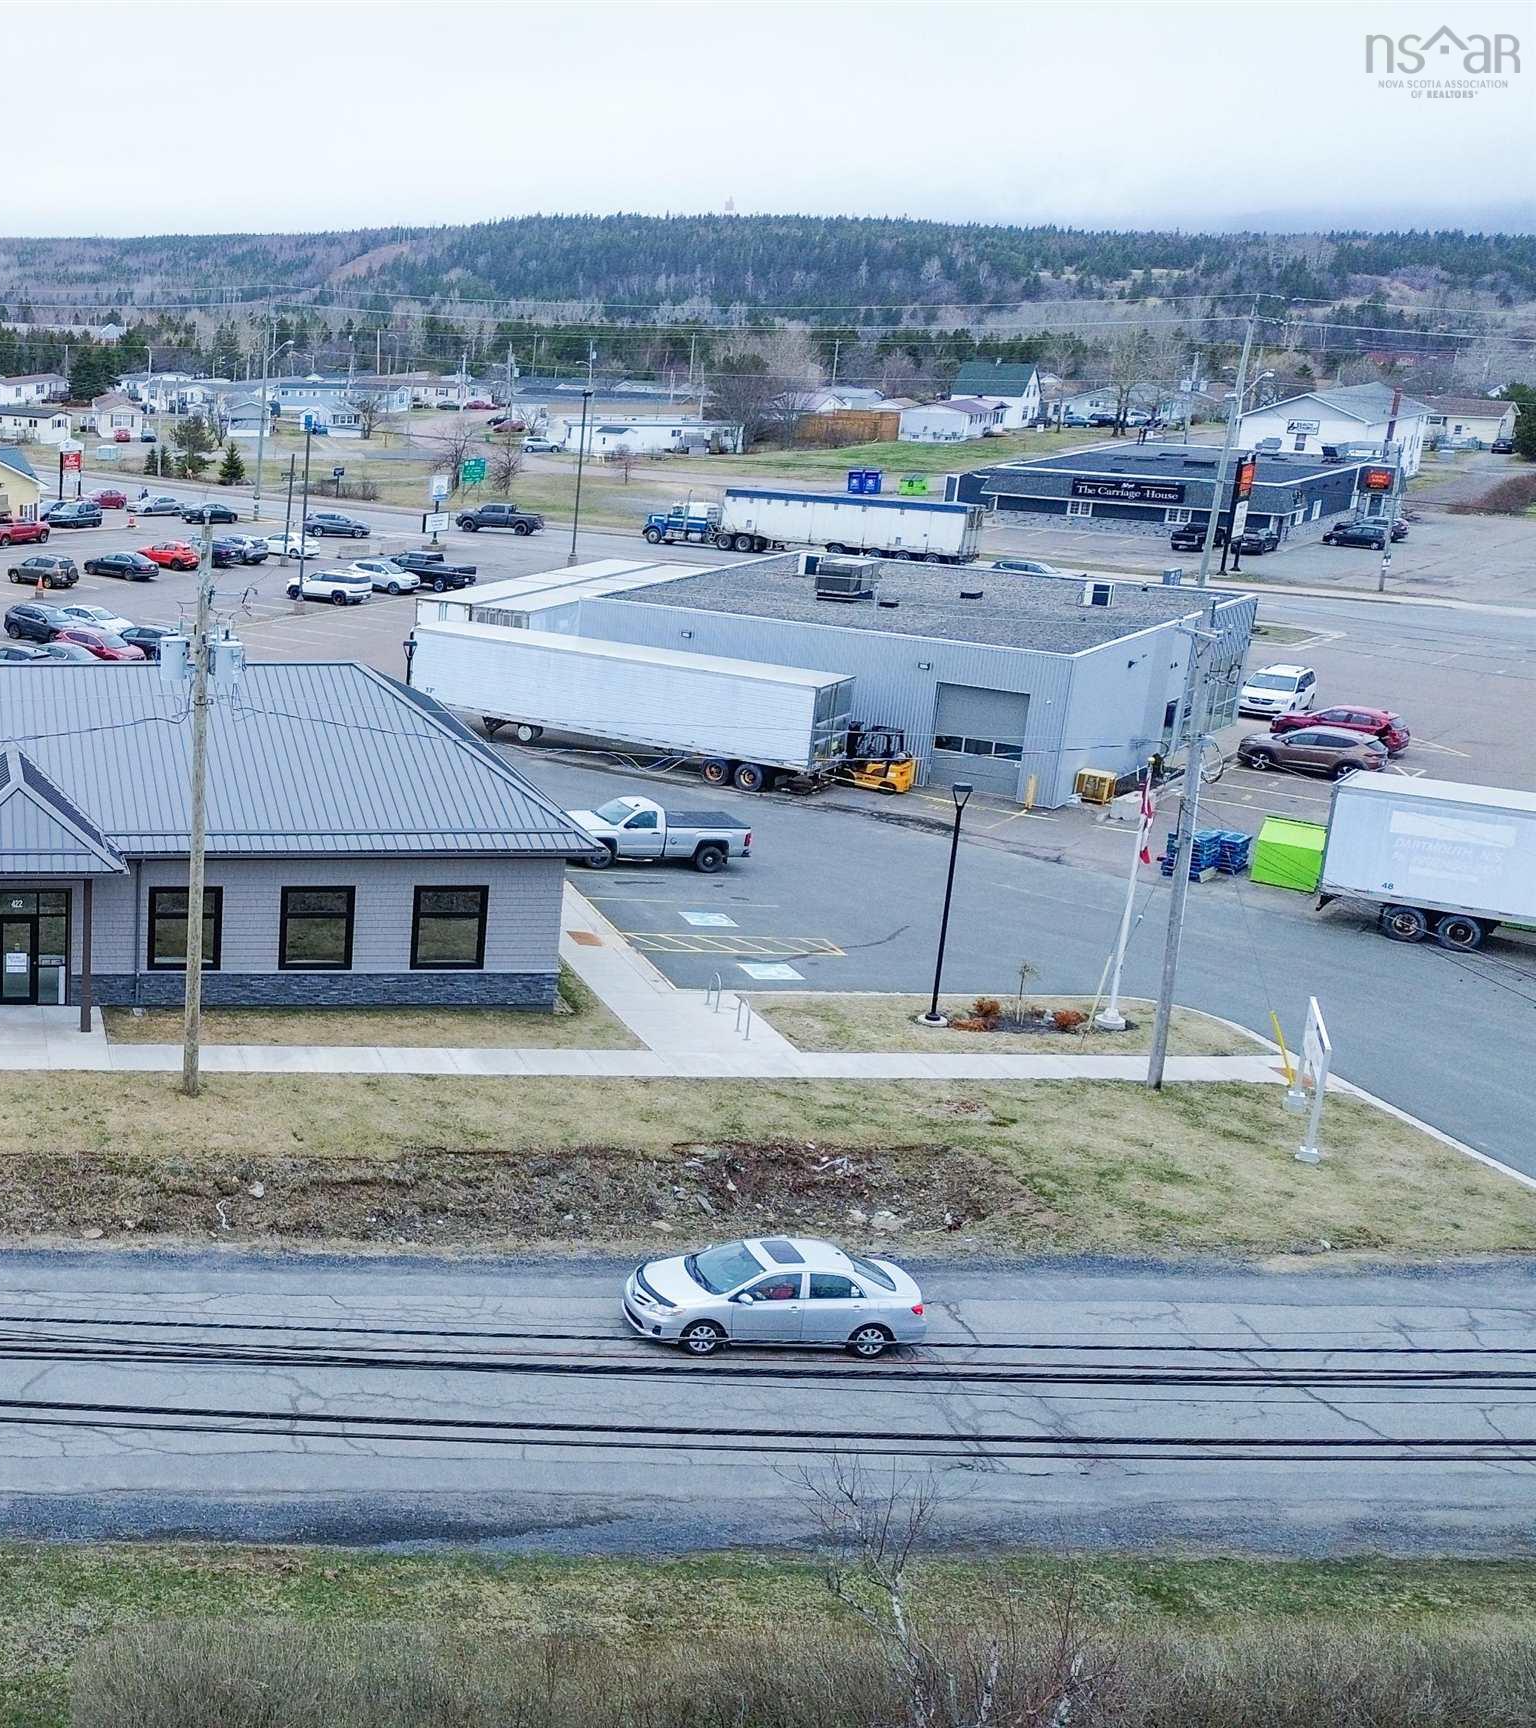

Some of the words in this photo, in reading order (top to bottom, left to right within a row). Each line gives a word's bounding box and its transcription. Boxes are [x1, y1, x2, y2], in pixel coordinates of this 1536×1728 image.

[1076, 485, 1096, 495] The
[1097, 486, 1142, 499] Carriage
[1145, 489, 1179, 500] House
[11, 899, 24, 908] 422
